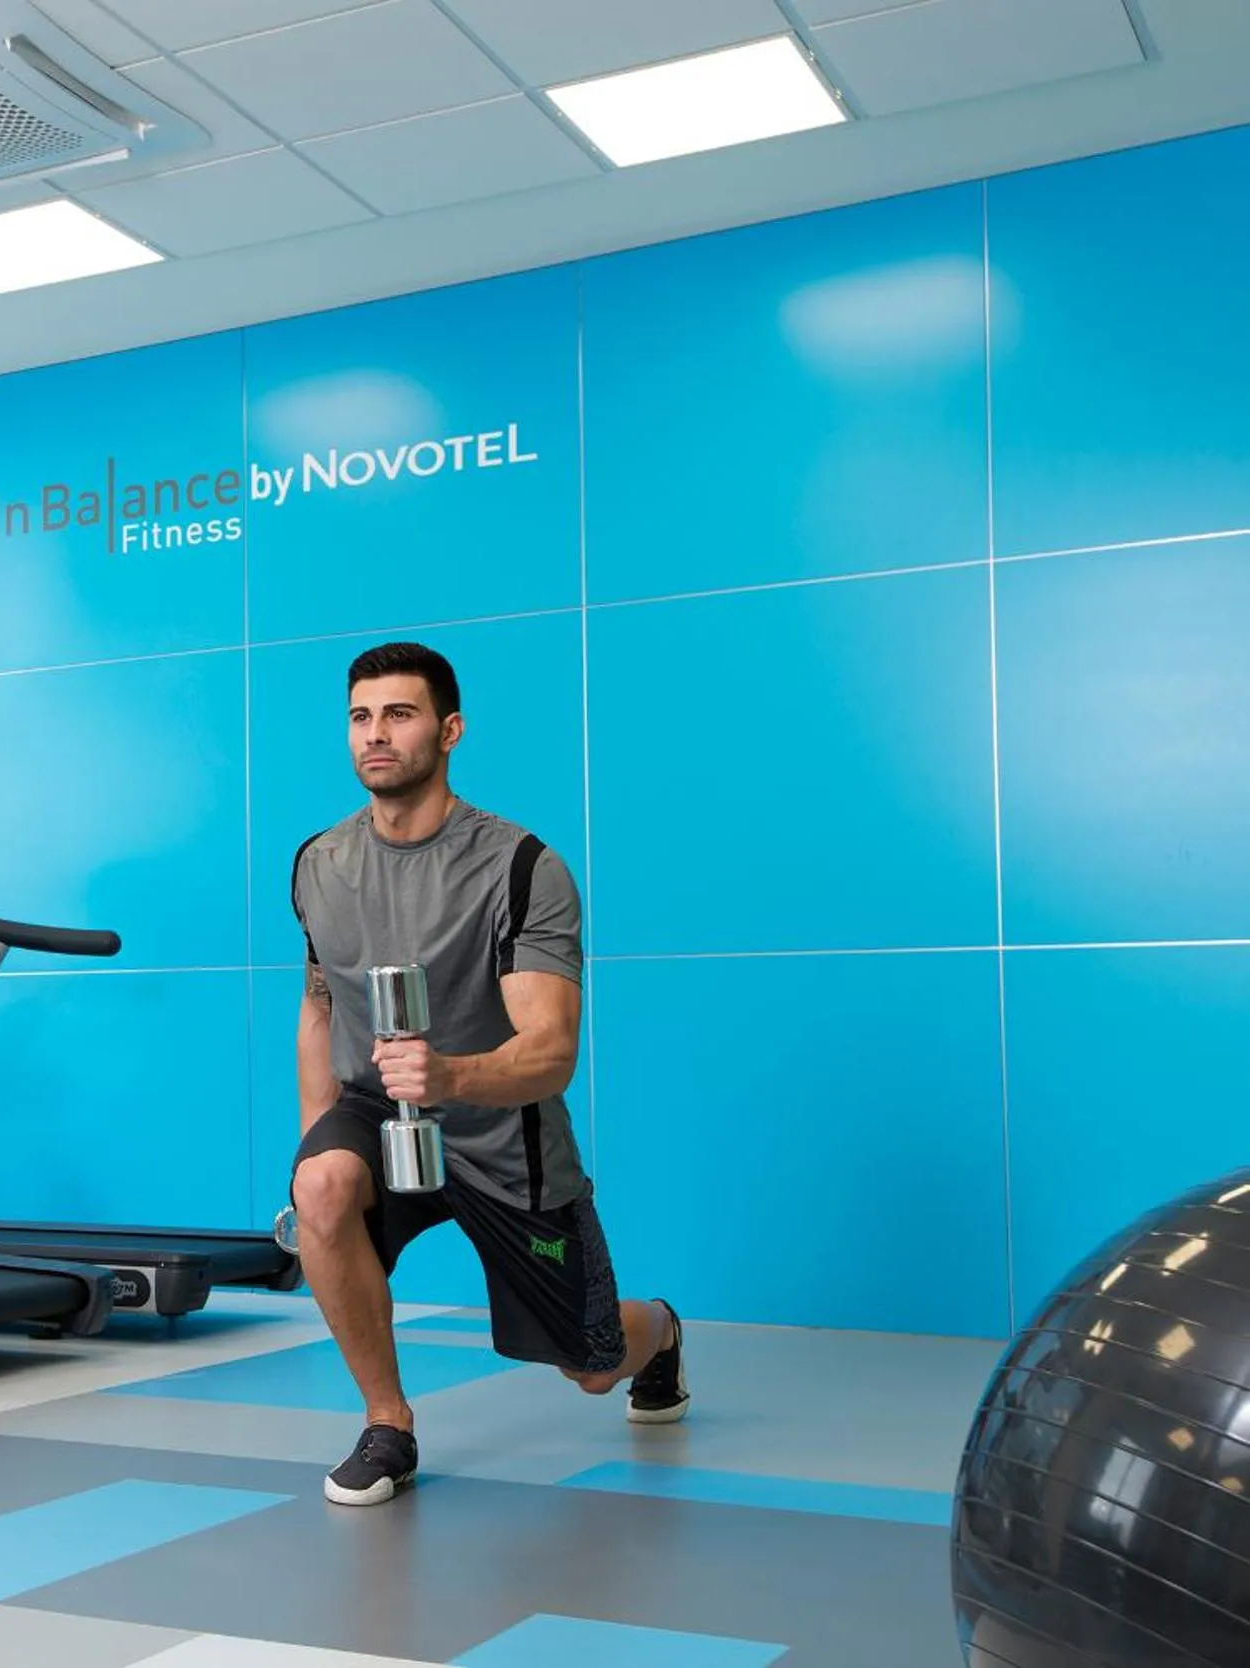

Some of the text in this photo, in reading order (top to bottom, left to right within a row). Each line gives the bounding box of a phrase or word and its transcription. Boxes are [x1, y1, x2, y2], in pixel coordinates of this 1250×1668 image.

[42, 457, 240, 553] Balance
[250, 464, 294, 505] by
[302, 424, 537, 492] NOVOTEL
[122, 517, 243, 553] Fitness
